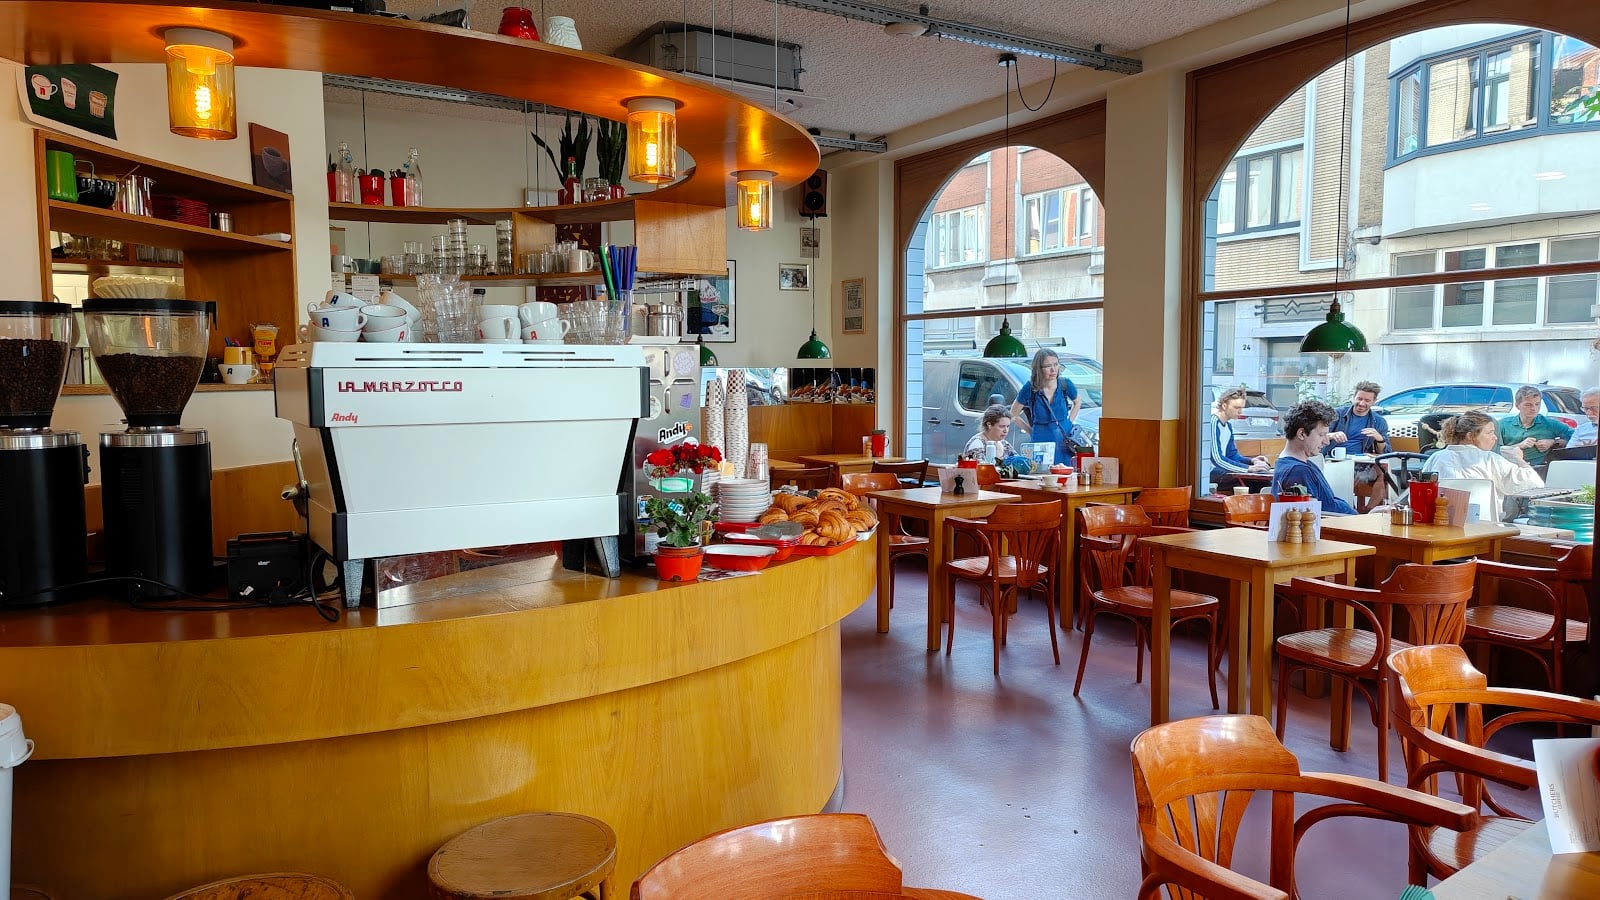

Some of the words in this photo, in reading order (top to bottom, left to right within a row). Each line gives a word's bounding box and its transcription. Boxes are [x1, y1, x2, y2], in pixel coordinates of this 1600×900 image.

[322, 317, 330, 327] A
[531, 331, 538, 340] A
[338, 381, 355, 393] LA
[363, 381, 463, 392] MARZOCCO
[331, 412, 358, 423] Andy
[659, 422, 686, 442] Andy
